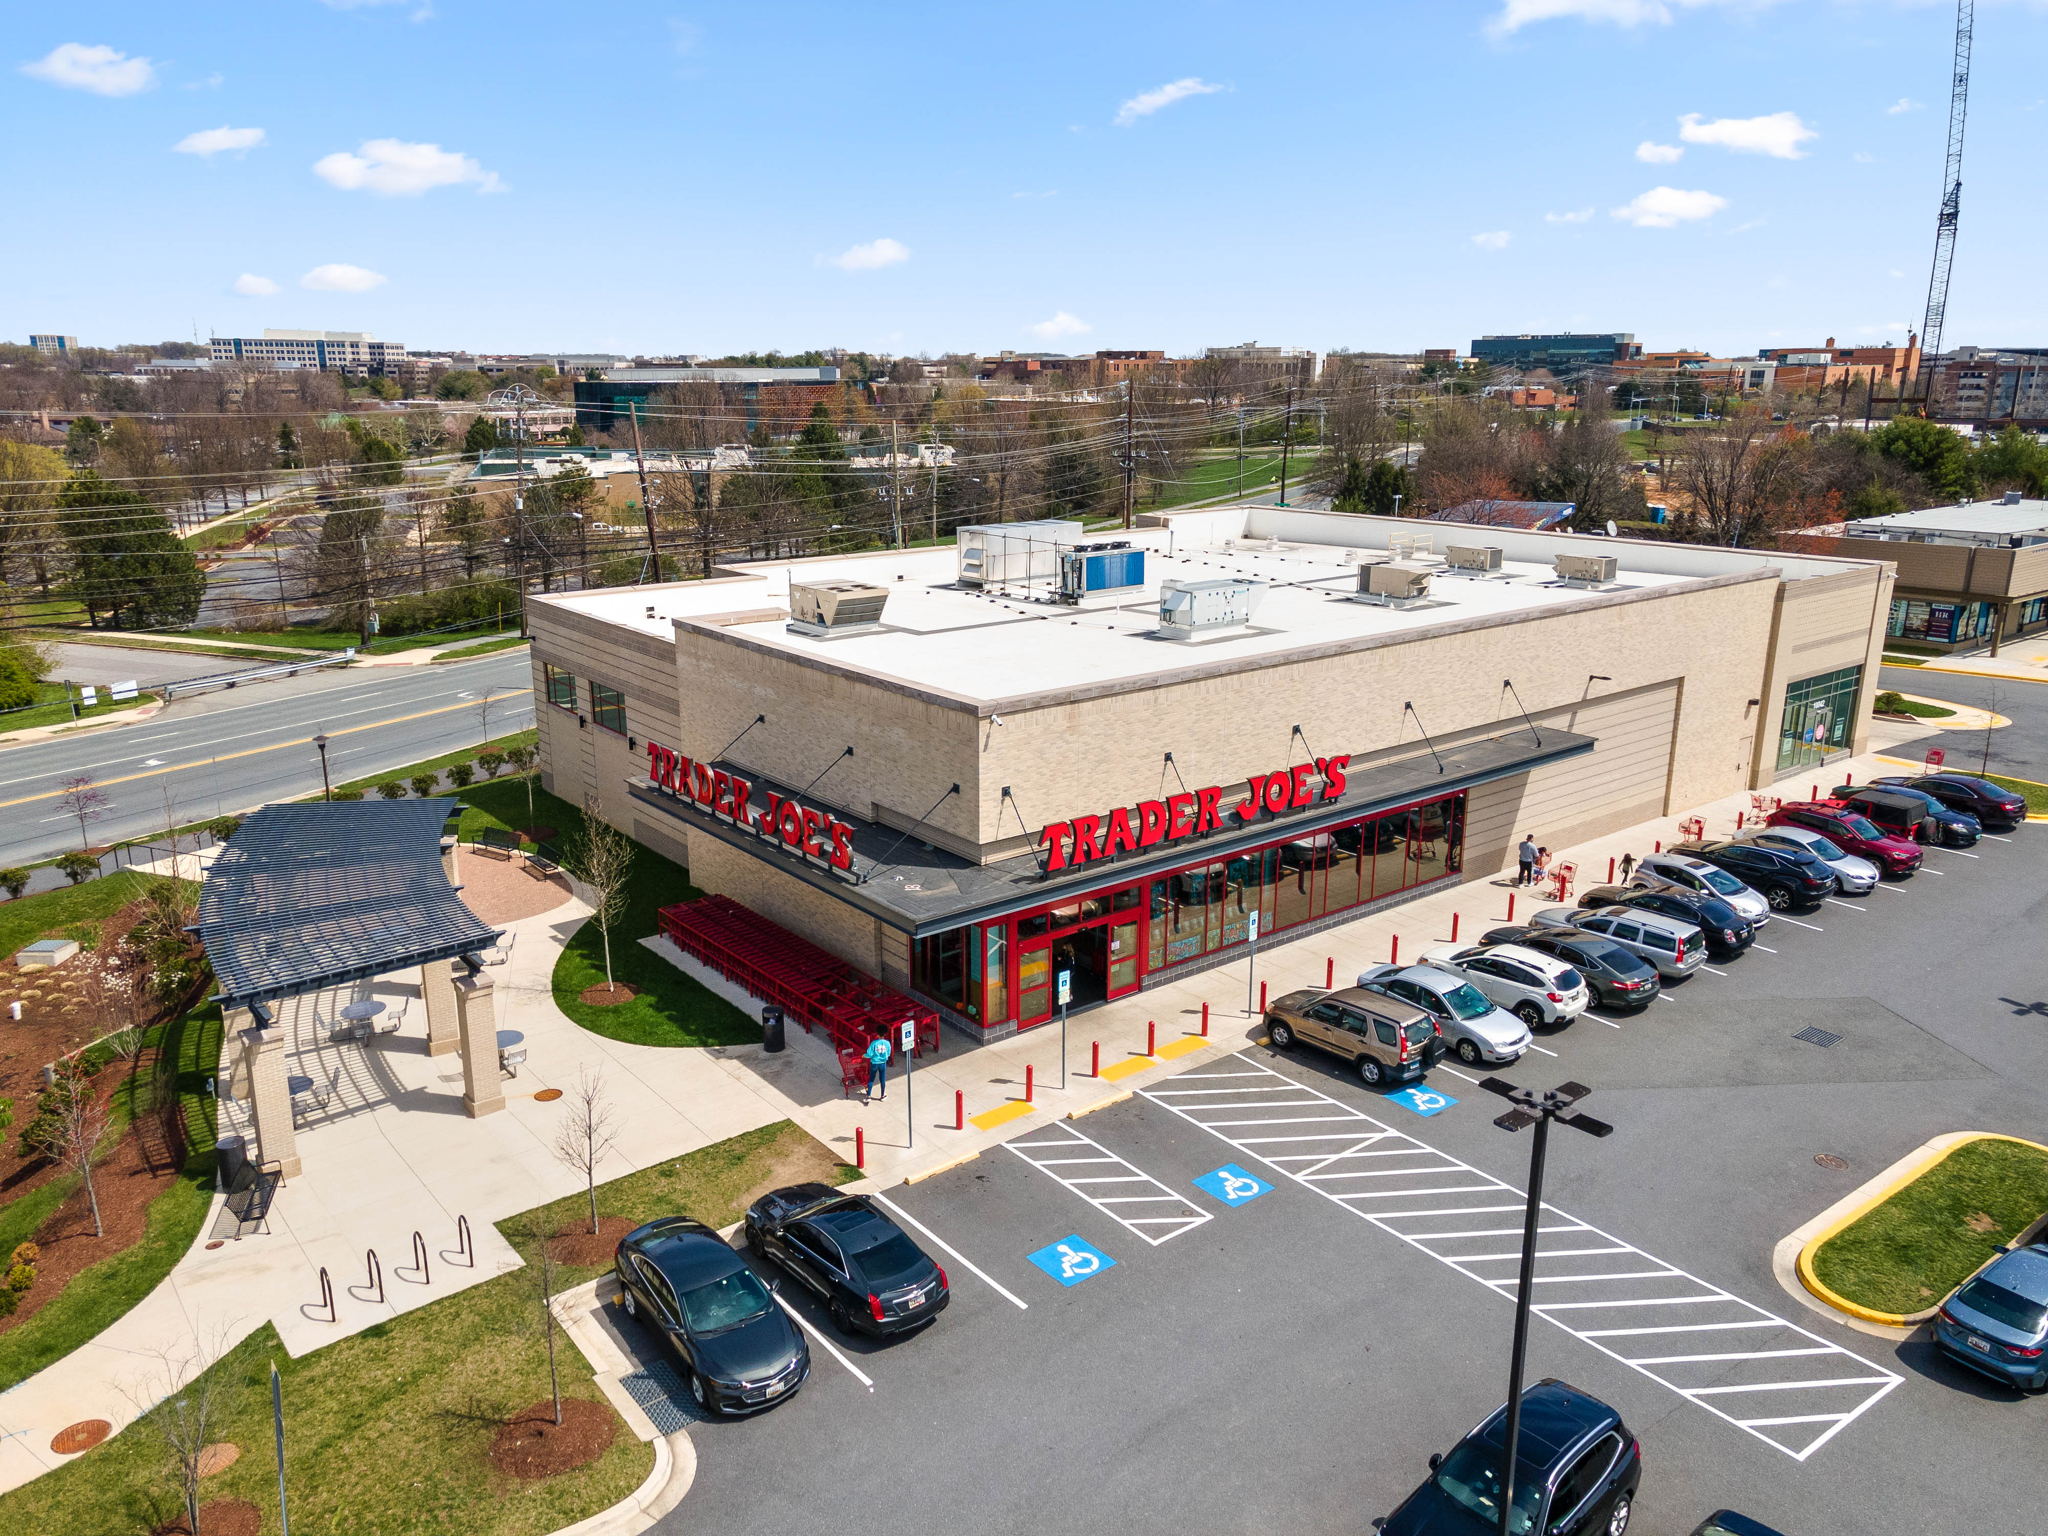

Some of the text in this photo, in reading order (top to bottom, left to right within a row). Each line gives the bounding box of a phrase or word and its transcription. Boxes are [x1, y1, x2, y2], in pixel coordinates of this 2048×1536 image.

[647, 742, 856, 870] TRADER JOE'S
[1038, 754, 1352, 872] TRADER JOE'S
